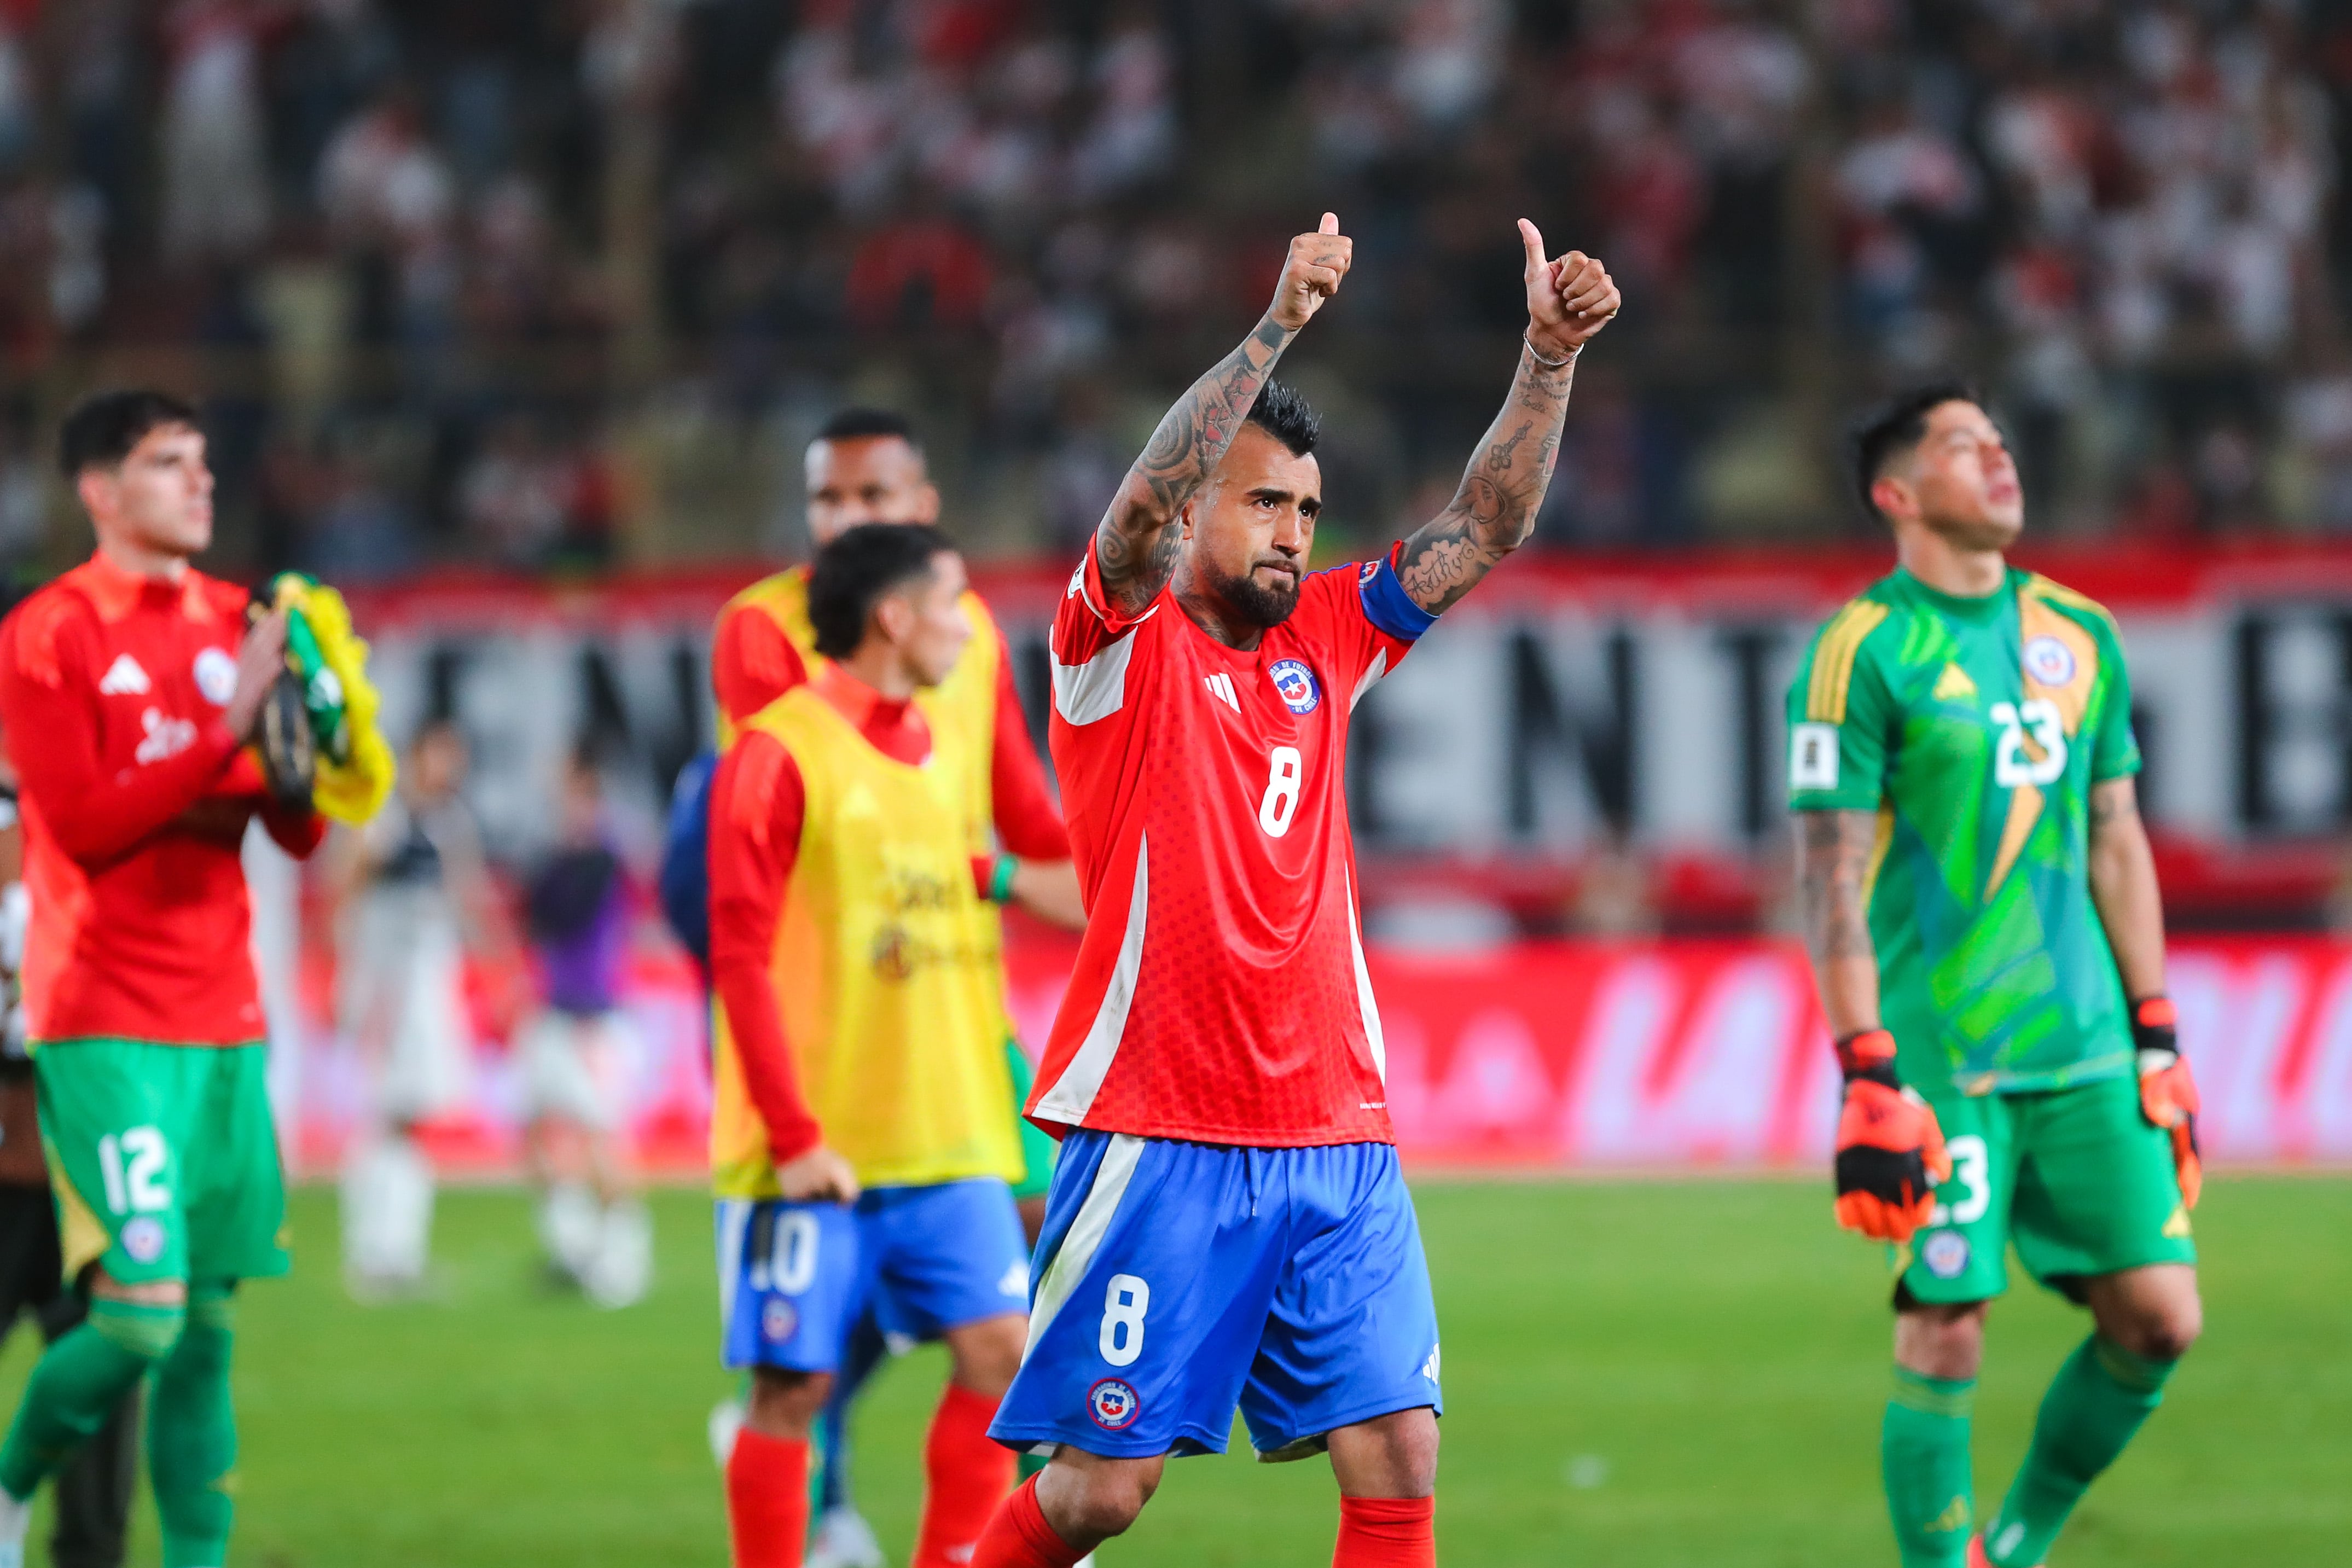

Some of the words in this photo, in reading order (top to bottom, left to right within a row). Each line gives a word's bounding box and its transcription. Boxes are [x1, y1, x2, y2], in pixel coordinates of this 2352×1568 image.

[1989, 698, 2068, 788] 23
[1259, 746, 1302, 838] 8
[98, 1125, 171, 1216] 12
[1099, 1273, 1150, 1367] 8
